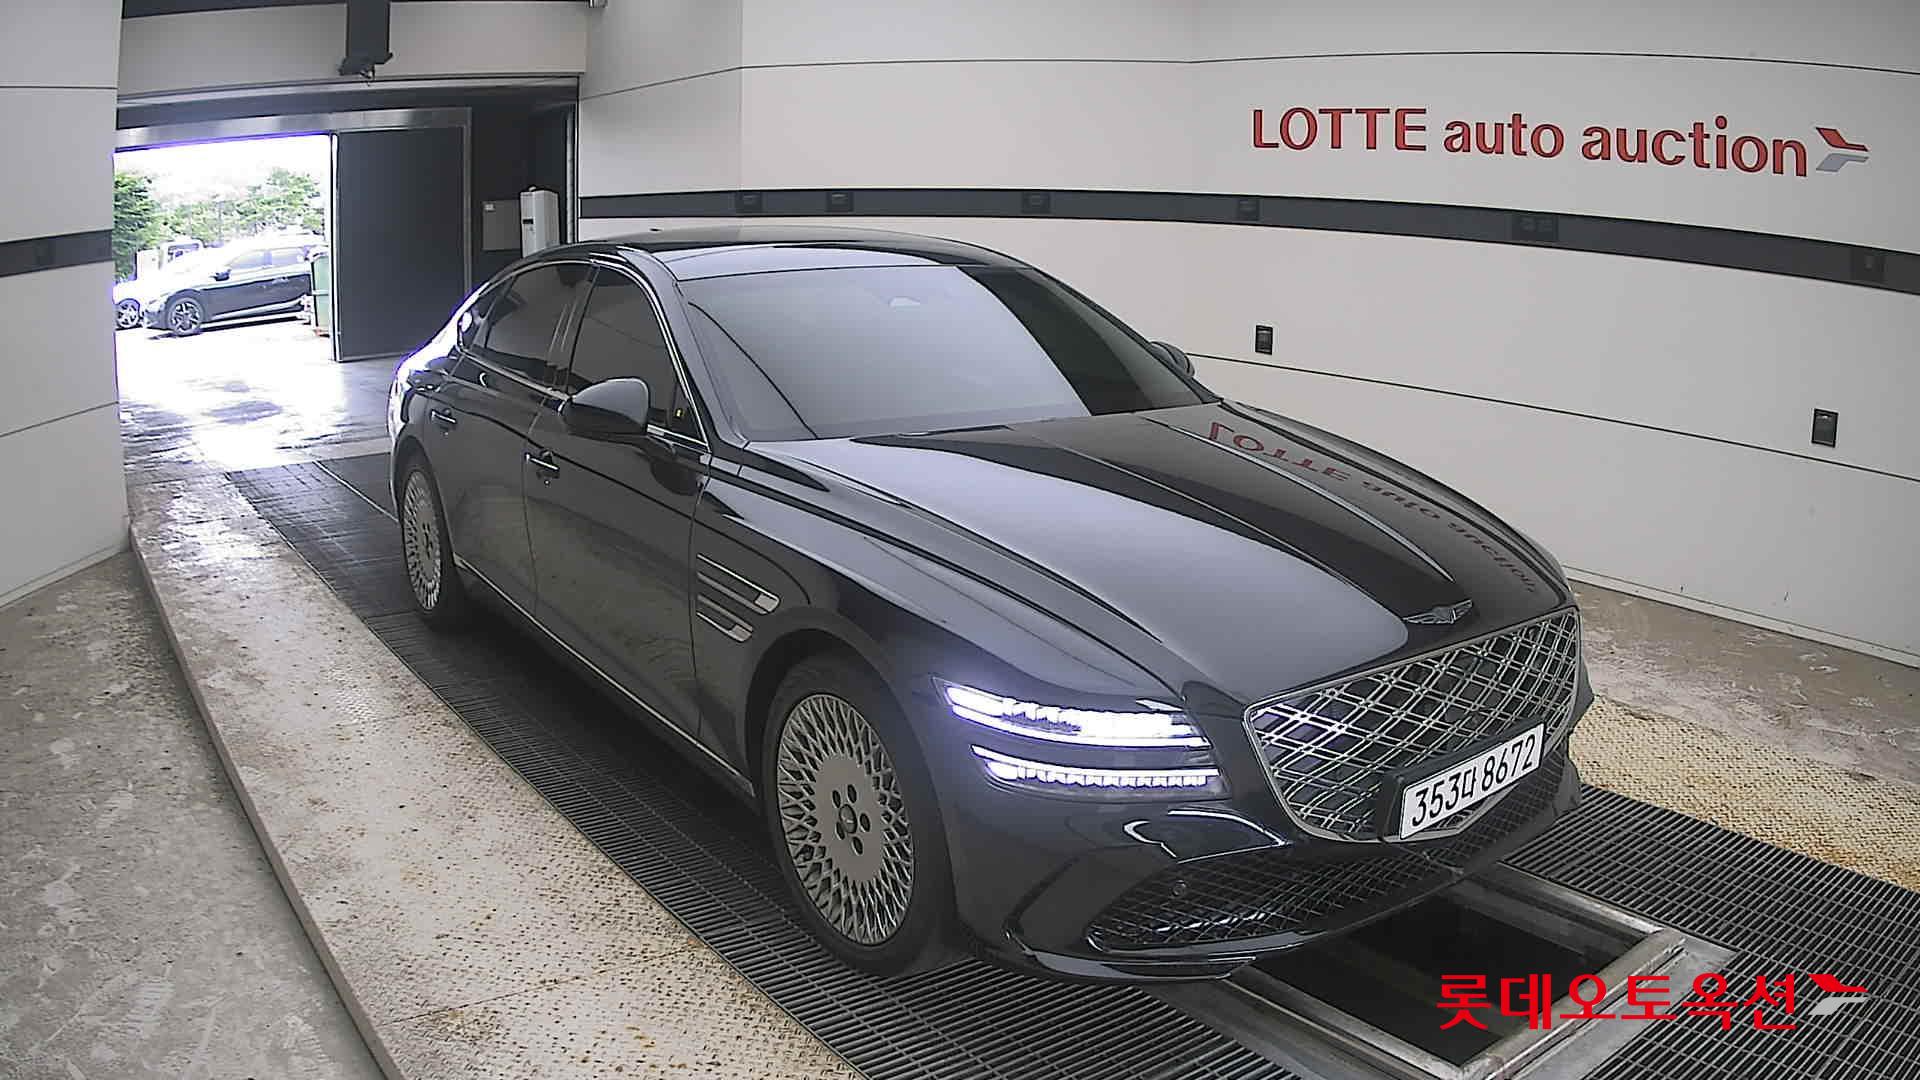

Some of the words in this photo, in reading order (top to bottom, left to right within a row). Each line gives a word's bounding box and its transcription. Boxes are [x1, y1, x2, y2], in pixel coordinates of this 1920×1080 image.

[1252, 107, 1428, 152] LOTTE
[1443, 112, 1566, 159] auto
[1580, 114, 1809, 178] auction
[1481, 734, 1536, 793] 8672
